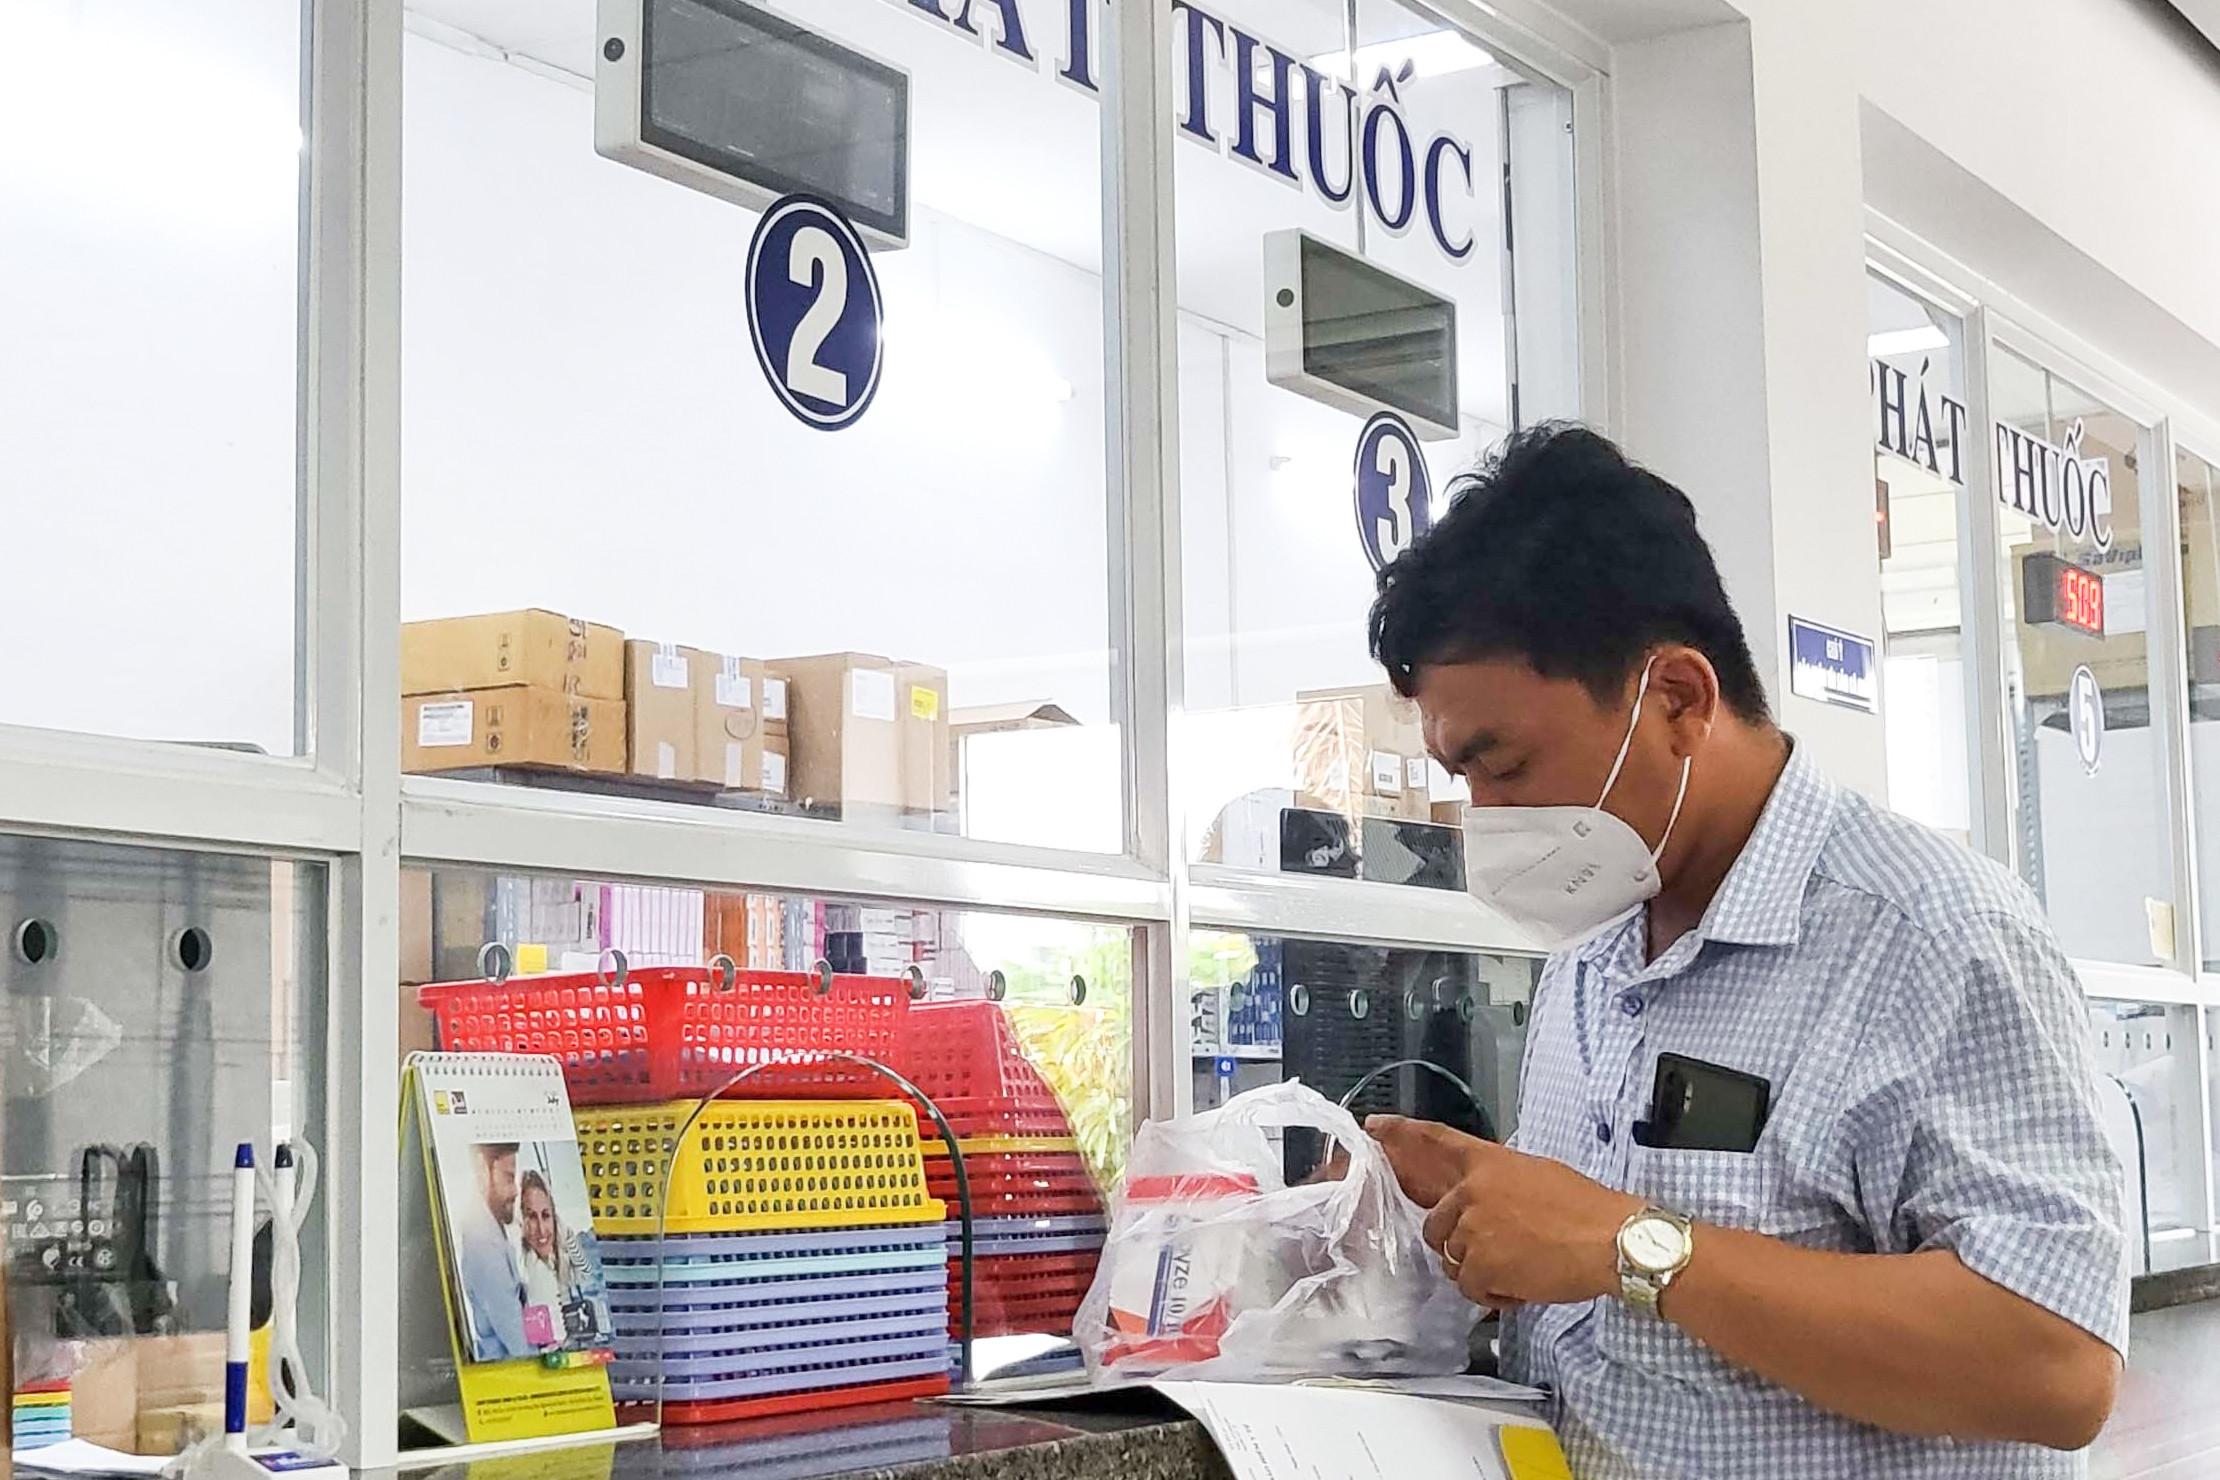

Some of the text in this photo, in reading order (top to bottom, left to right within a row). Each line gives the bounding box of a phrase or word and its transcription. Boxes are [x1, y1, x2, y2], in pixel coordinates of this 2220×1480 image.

[1171, 1, 1474, 258] THUỐC
[787, 226, 848, 407] 2
[1870, 356, 1967, 486] HÁT
[1375, 433, 1414, 565] 3
[2078, 675, 2096, 764] 5
